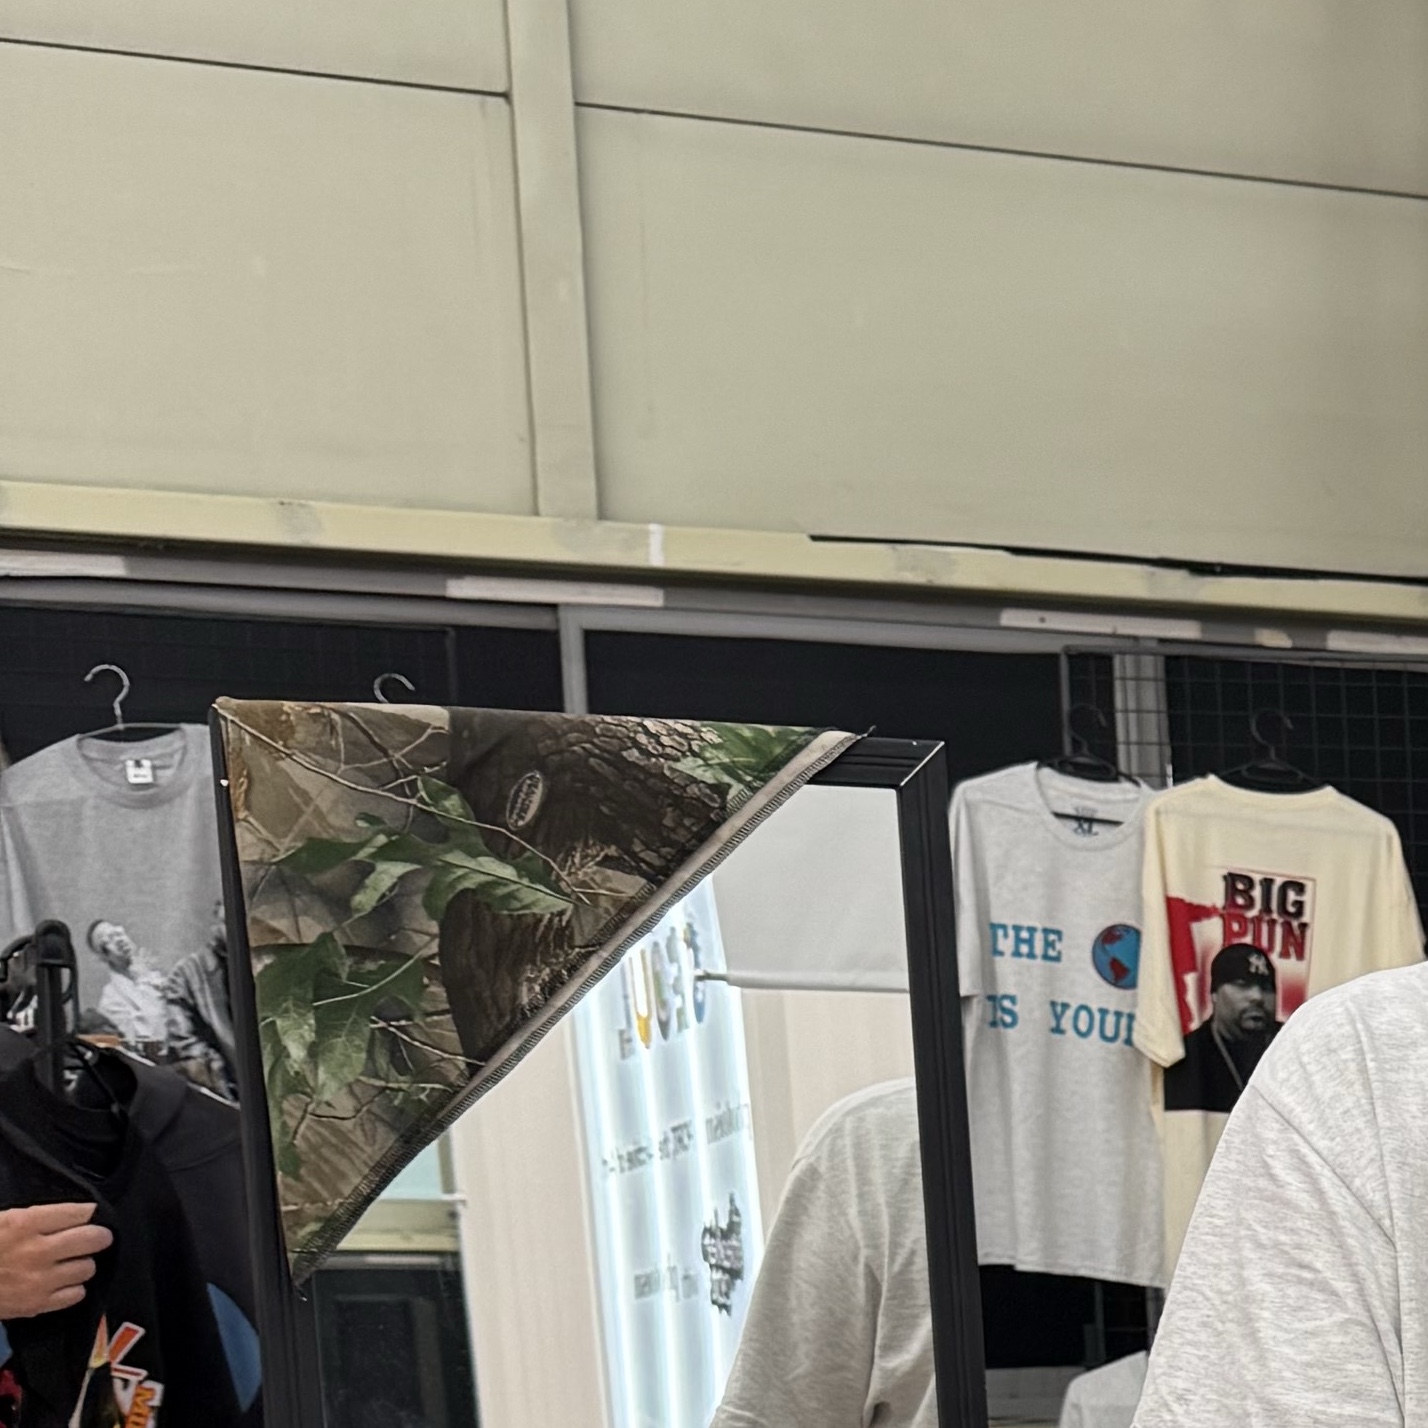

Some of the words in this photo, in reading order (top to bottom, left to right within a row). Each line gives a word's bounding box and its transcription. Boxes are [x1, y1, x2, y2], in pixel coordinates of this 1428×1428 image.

[1223, 872, 1307, 920] BIG
[989, 921, 1063, 962] THE
[1221, 912, 1309, 961] PUN
[987, 994, 1018, 1029] IS
